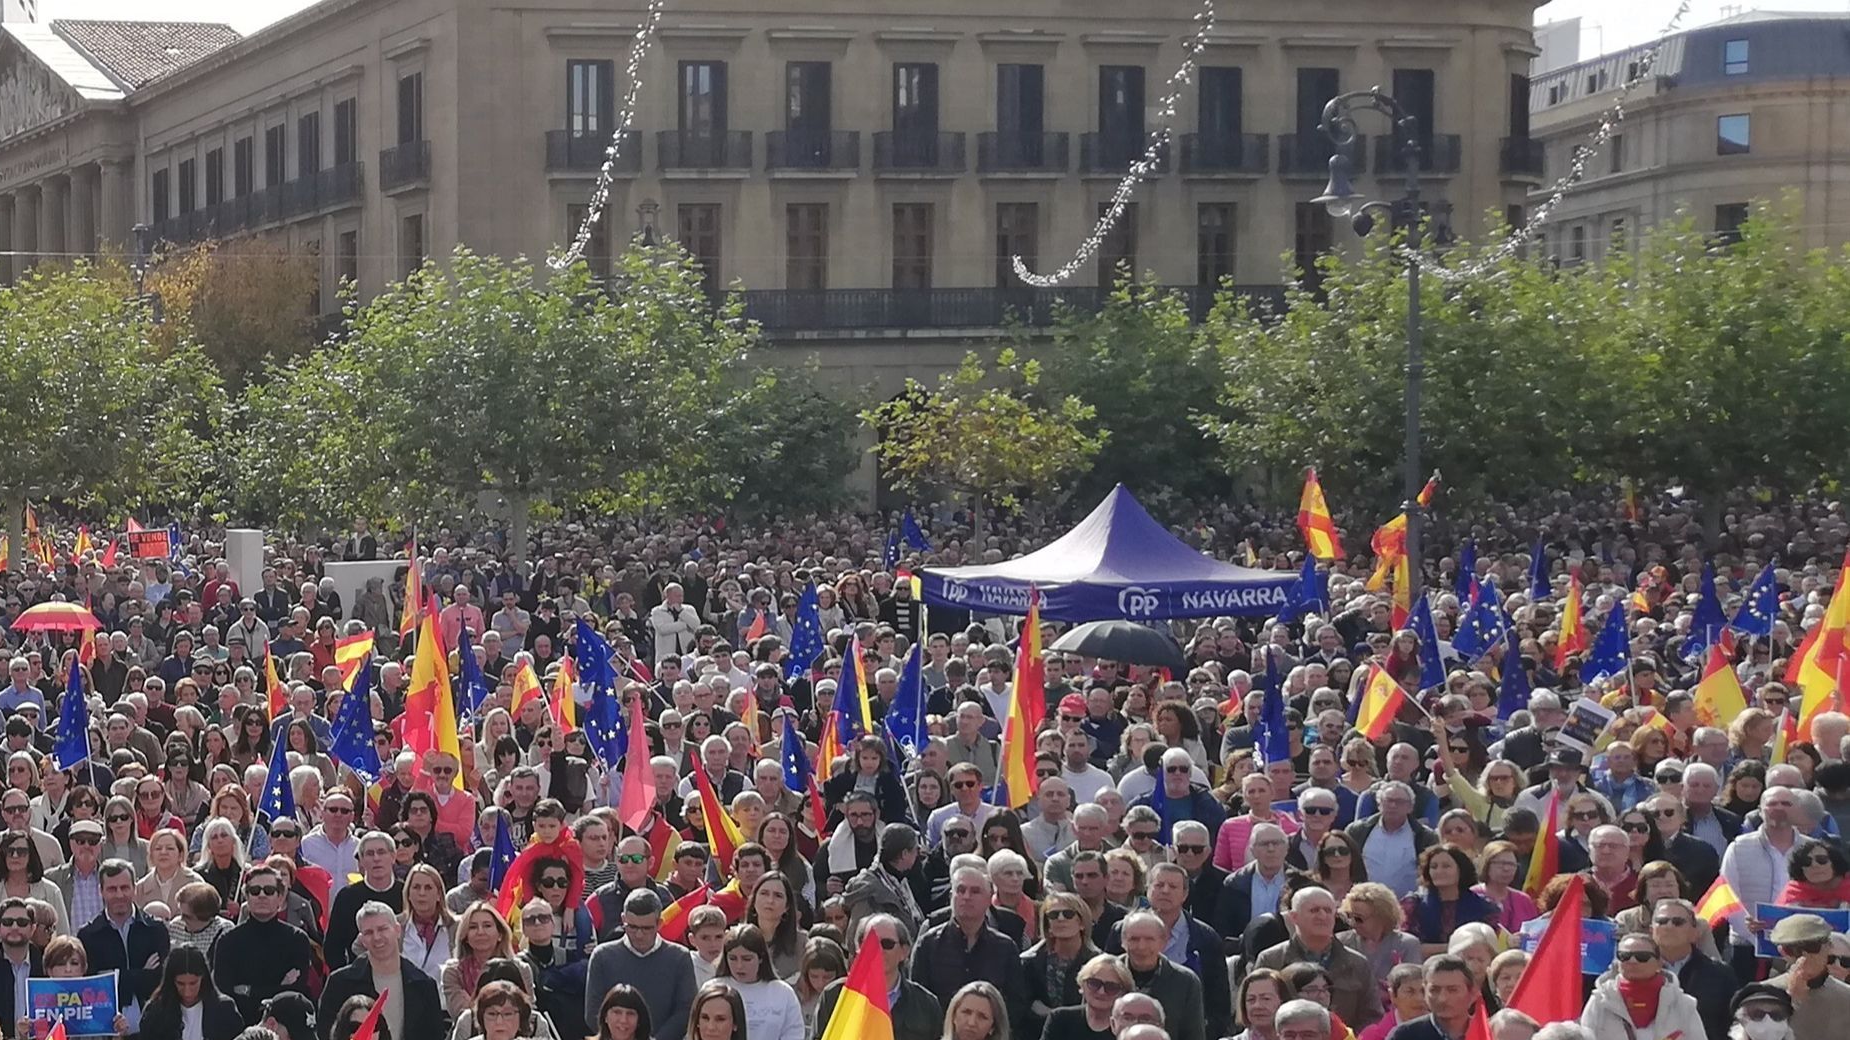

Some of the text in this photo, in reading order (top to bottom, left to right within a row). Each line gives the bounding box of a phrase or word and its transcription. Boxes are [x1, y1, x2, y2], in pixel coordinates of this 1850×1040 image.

[141, 530, 167, 542] VENDE
[1182, 586, 1289, 609] NAVARRA
[34, 987, 110, 1008] ESPAÑA
[34, 1006, 93, 1022] EN PIE
